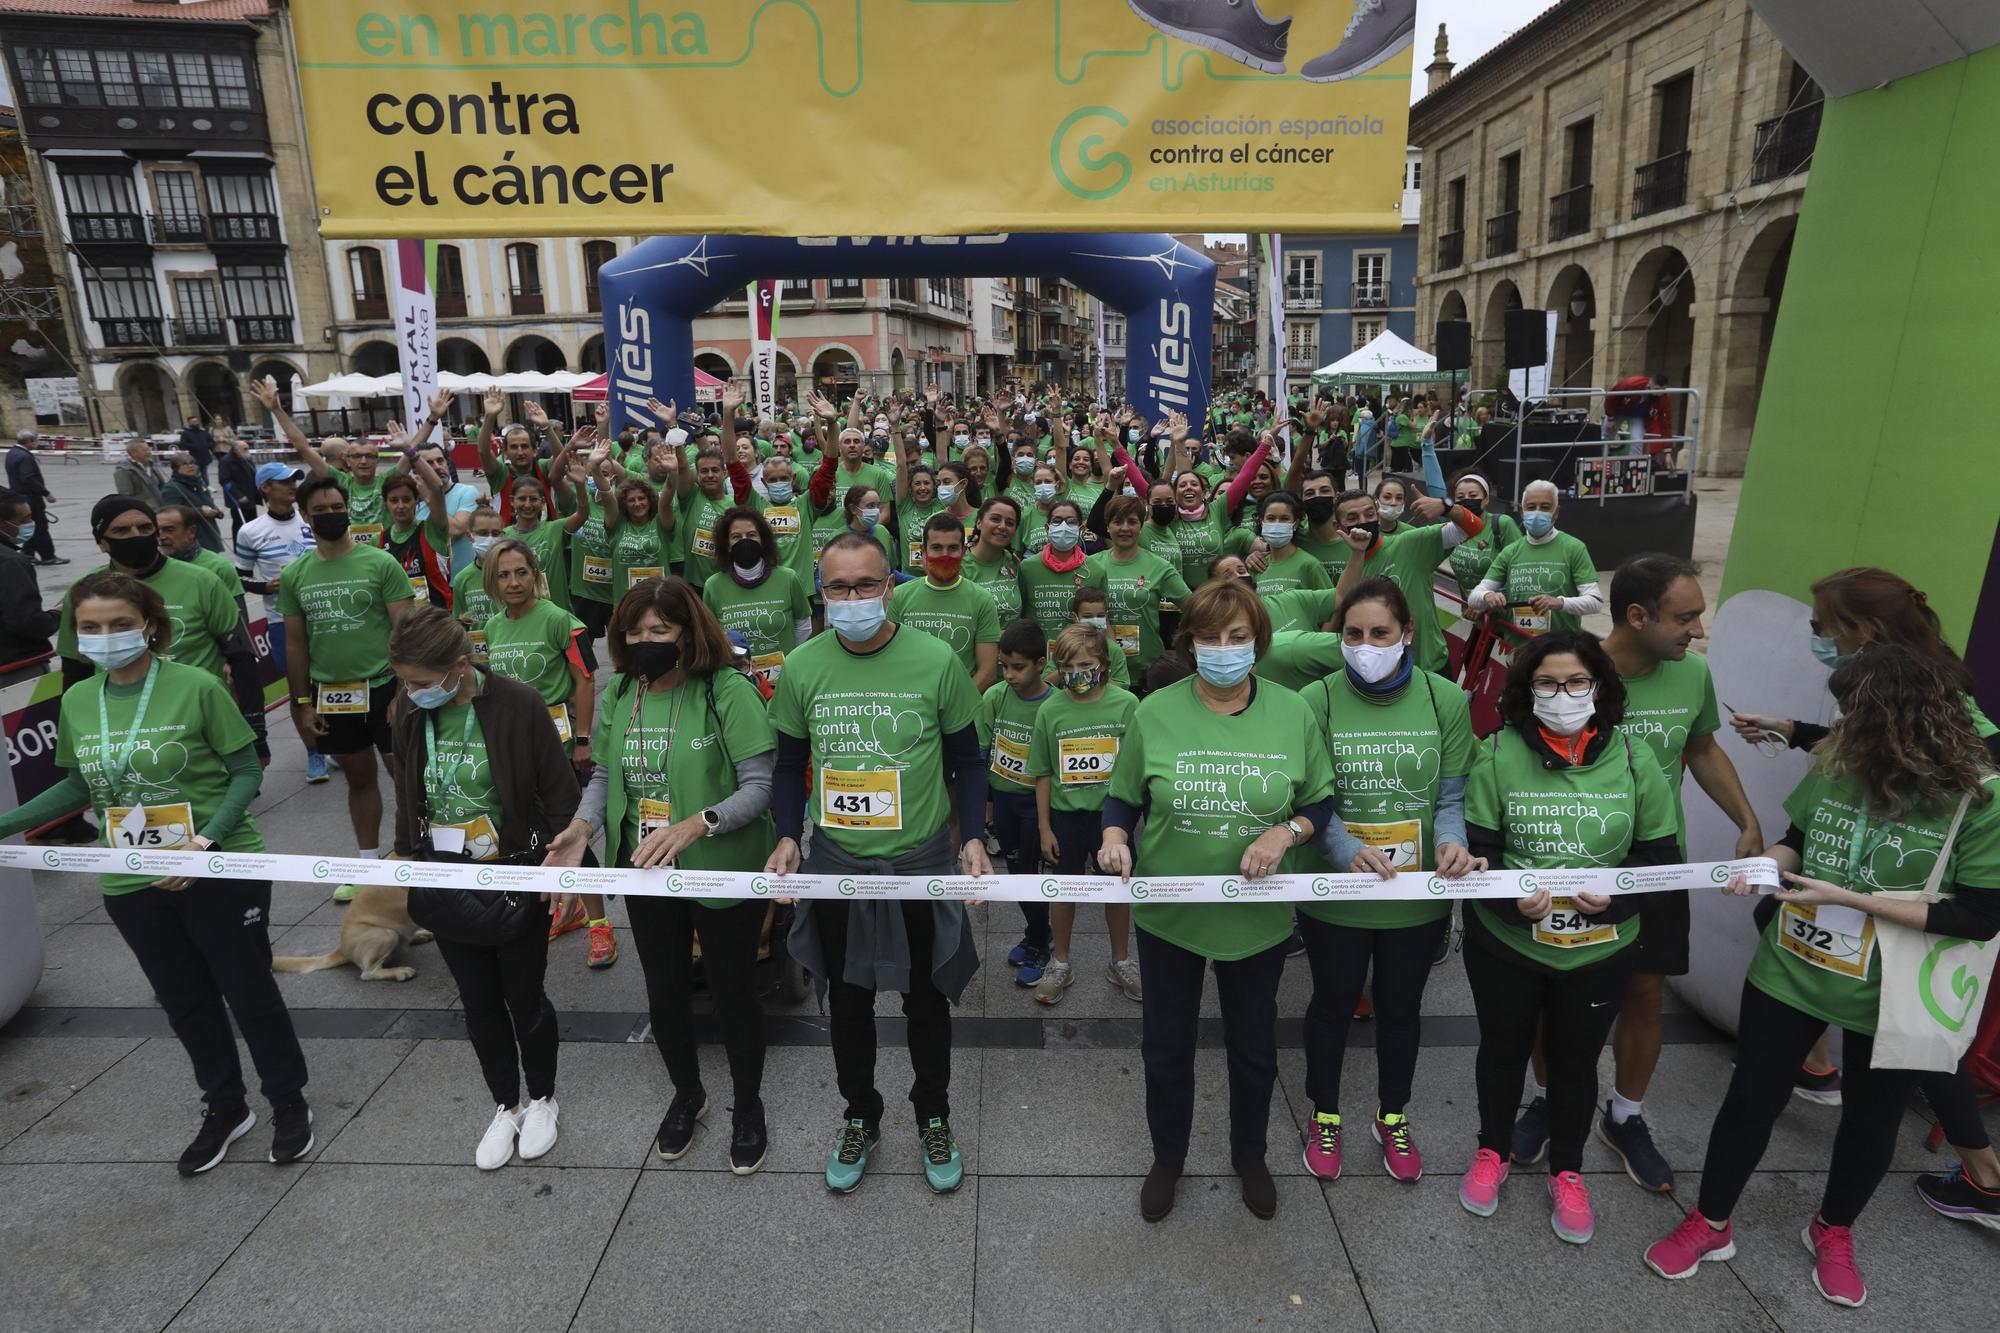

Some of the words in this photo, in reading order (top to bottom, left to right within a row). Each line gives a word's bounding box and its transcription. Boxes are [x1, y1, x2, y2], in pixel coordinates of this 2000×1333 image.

[356, 11, 440, 57] en
[459, 0, 710, 57] marcha
[366, 82, 579, 135] contra
[1151, 114, 1271, 135] asociación
[1279, 114, 1384, 139] española
[1150, 143, 1223, 163] contra
[1230, 143, 1249, 163] el
[1256, 143, 1334, 163] cáncer
[375, 151, 437, 206] el
[453, 151, 673, 205] cáncer
[1150, 175, 1176, 192] en
[1183, 171, 1274, 192] Asturias
[770, 517, 788, 526] 471
[1520, 566, 1550, 574] marcha
[300, 592, 310, 602] En
[313, 587, 349, 598] marcha
[1034, 590, 1043, 599] En
[304, 600, 331, 610] contra
[1035, 600, 1060, 608] contra
[722, 612, 731, 620] En
[734, 607, 767, 617] marcha
[724, 619, 750, 630] contra
[915, 618, 952, 628] marcha
[1520, 618, 1532, 627] 44
[492, 648, 523, 659] marcha
[326, 693, 352, 704] 622
[815, 704, 830, 718] En
[834, 701, 891, 716] marcha
[816, 721, 860, 735] contra
[5, 720, 58, 766] BOR
[625, 736, 668, 750] march
[819, 738, 827, 753] el
[829, 737, 881, 753] cáncer
[1334, 742, 1351, 755] En
[1357, 740, 1414, 755] marcha
[76, 745, 89, 757] En
[434, 750, 475, 763] archa
[80, 760, 117, 773] onta
[622, 755, 647, 767] ntra
[1000, 755, 1023, 772] 672
[1068, 757, 1100, 770] 260
[1335, 759, 1383, 772] contra
[1176, 761, 1194, 774] En
[1200, 761, 1260, 776] marcha
[625, 770, 668, 782] cáncer
[1337, 777, 1347, 789] el
[1352, 776, 1402, 790] cáncer
[1174, 779, 1226, 792] contra
[834, 796, 871, 812] 431
[1173, 794, 1187, 809] el
[1191, 796, 1247, 811] cáncer
[1508, 801, 1527, 816] En
[1533, 801, 1598, 817] marcha
[1814, 807, 1832, 824] En
[1510, 821, 1562, 835] contra
[1907, 825, 1917, 833] EL
[1918, 828, 1946, 840] CÁNCE
[1514, 837, 1525, 850] el
[1529, 838, 1585, 854] cáncer
[1810, 828, 1852, 850] contr
[1807, 844, 1816, 859] el
[1817, 850, 1876, 880] cáner
[1793, 919, 1833, 951] 372
